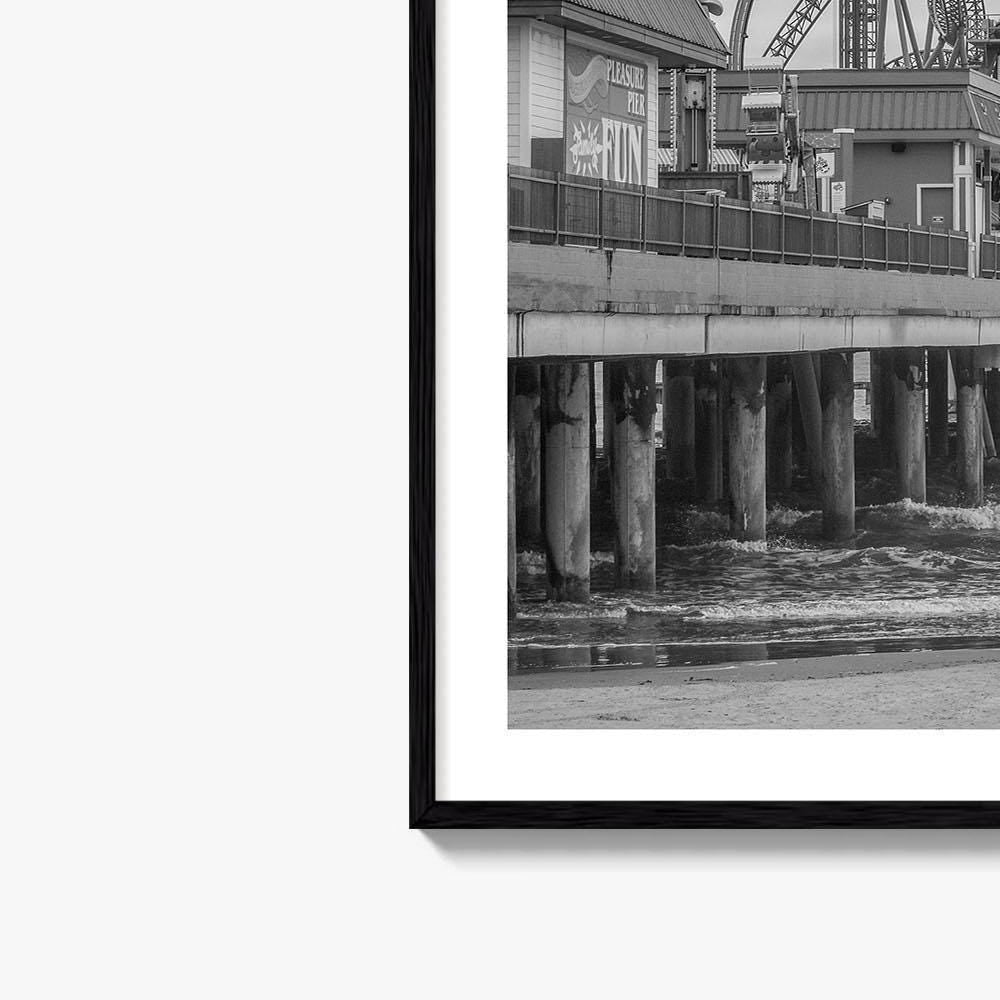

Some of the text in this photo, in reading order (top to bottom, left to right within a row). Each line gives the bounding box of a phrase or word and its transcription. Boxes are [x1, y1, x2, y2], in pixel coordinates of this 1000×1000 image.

[607, 59, 645, 90] PLEASURE
[627, 91, 645, 116] PIER
[601, 117, 643, 185] FUN
